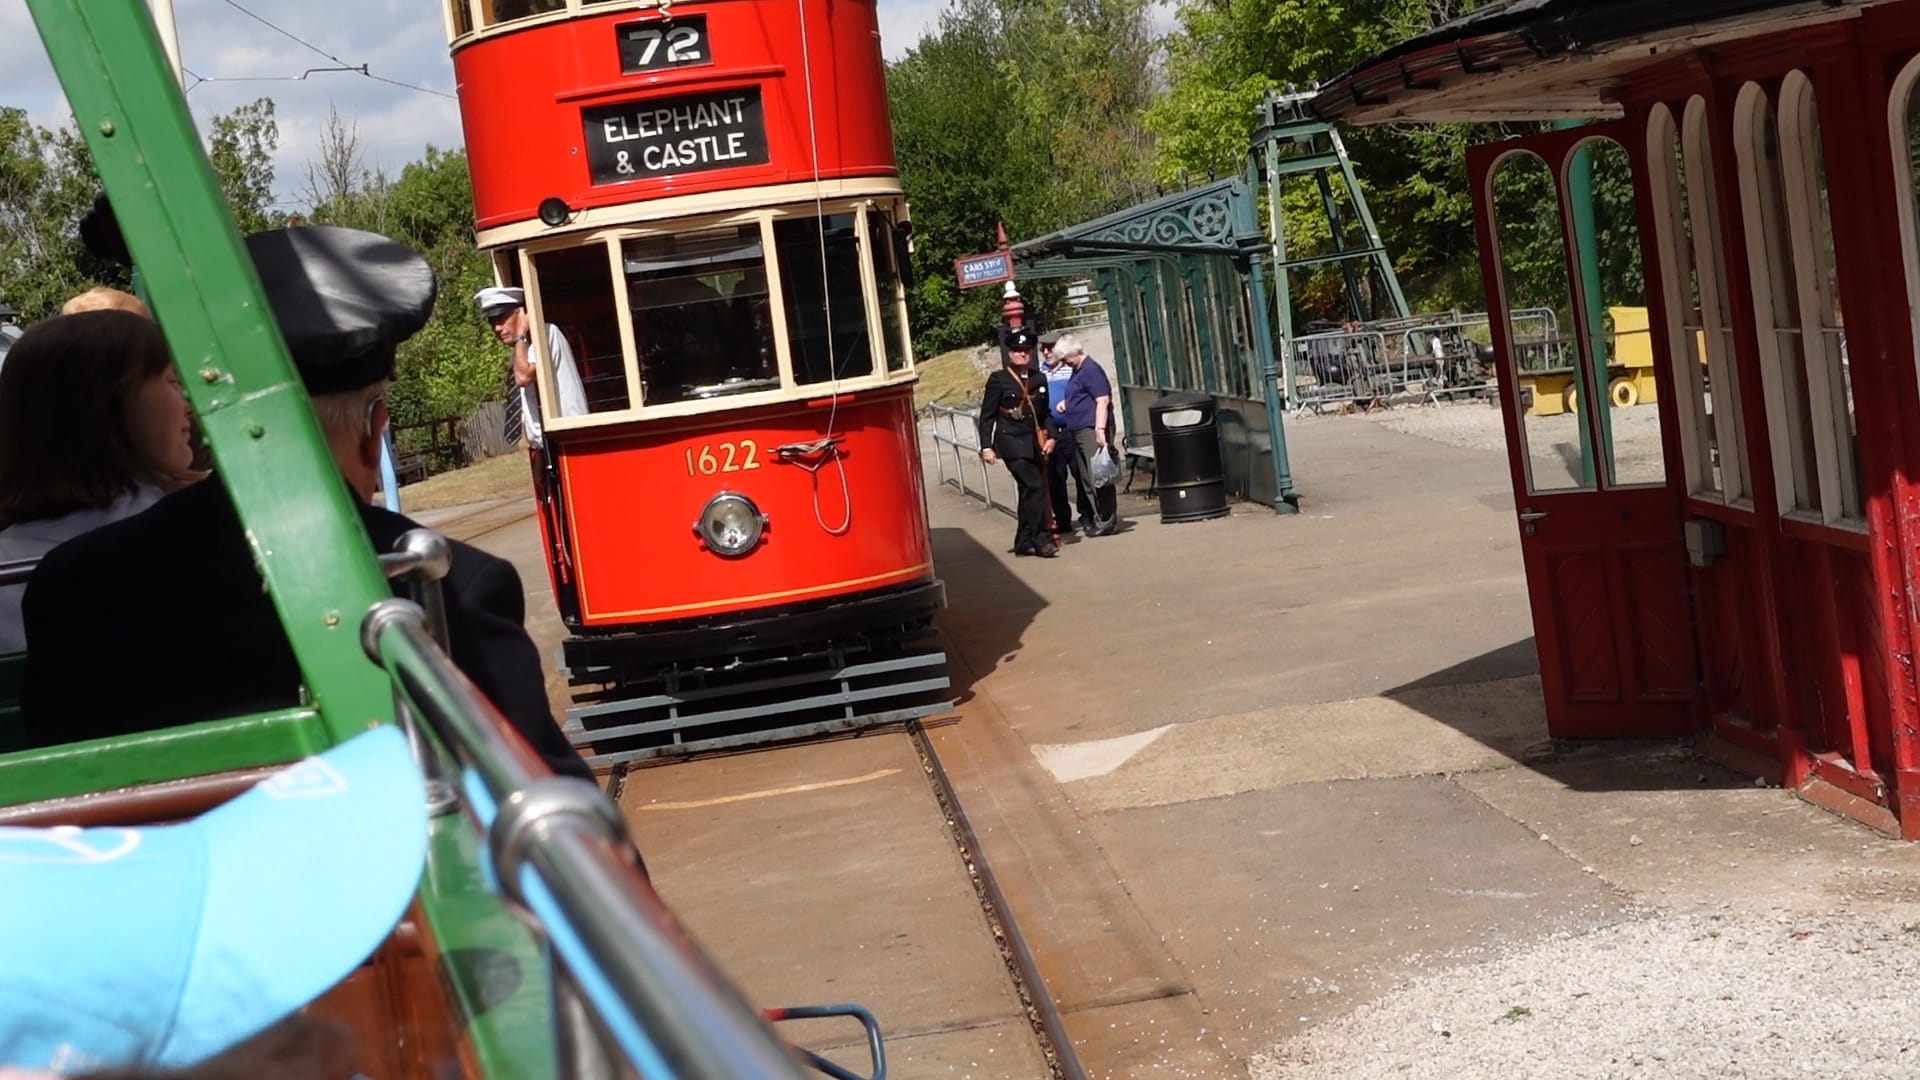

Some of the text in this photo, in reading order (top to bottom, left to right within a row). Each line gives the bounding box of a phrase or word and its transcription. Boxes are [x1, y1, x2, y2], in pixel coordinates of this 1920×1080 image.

[629, 26, 701, 66] 72
[603, 98, 747, 143] ELEPHANT
[616, 132, 748, 174] & CASTLE
[964, 262, 983, 273] CARS
[685, 439, 761, 477] 1622
